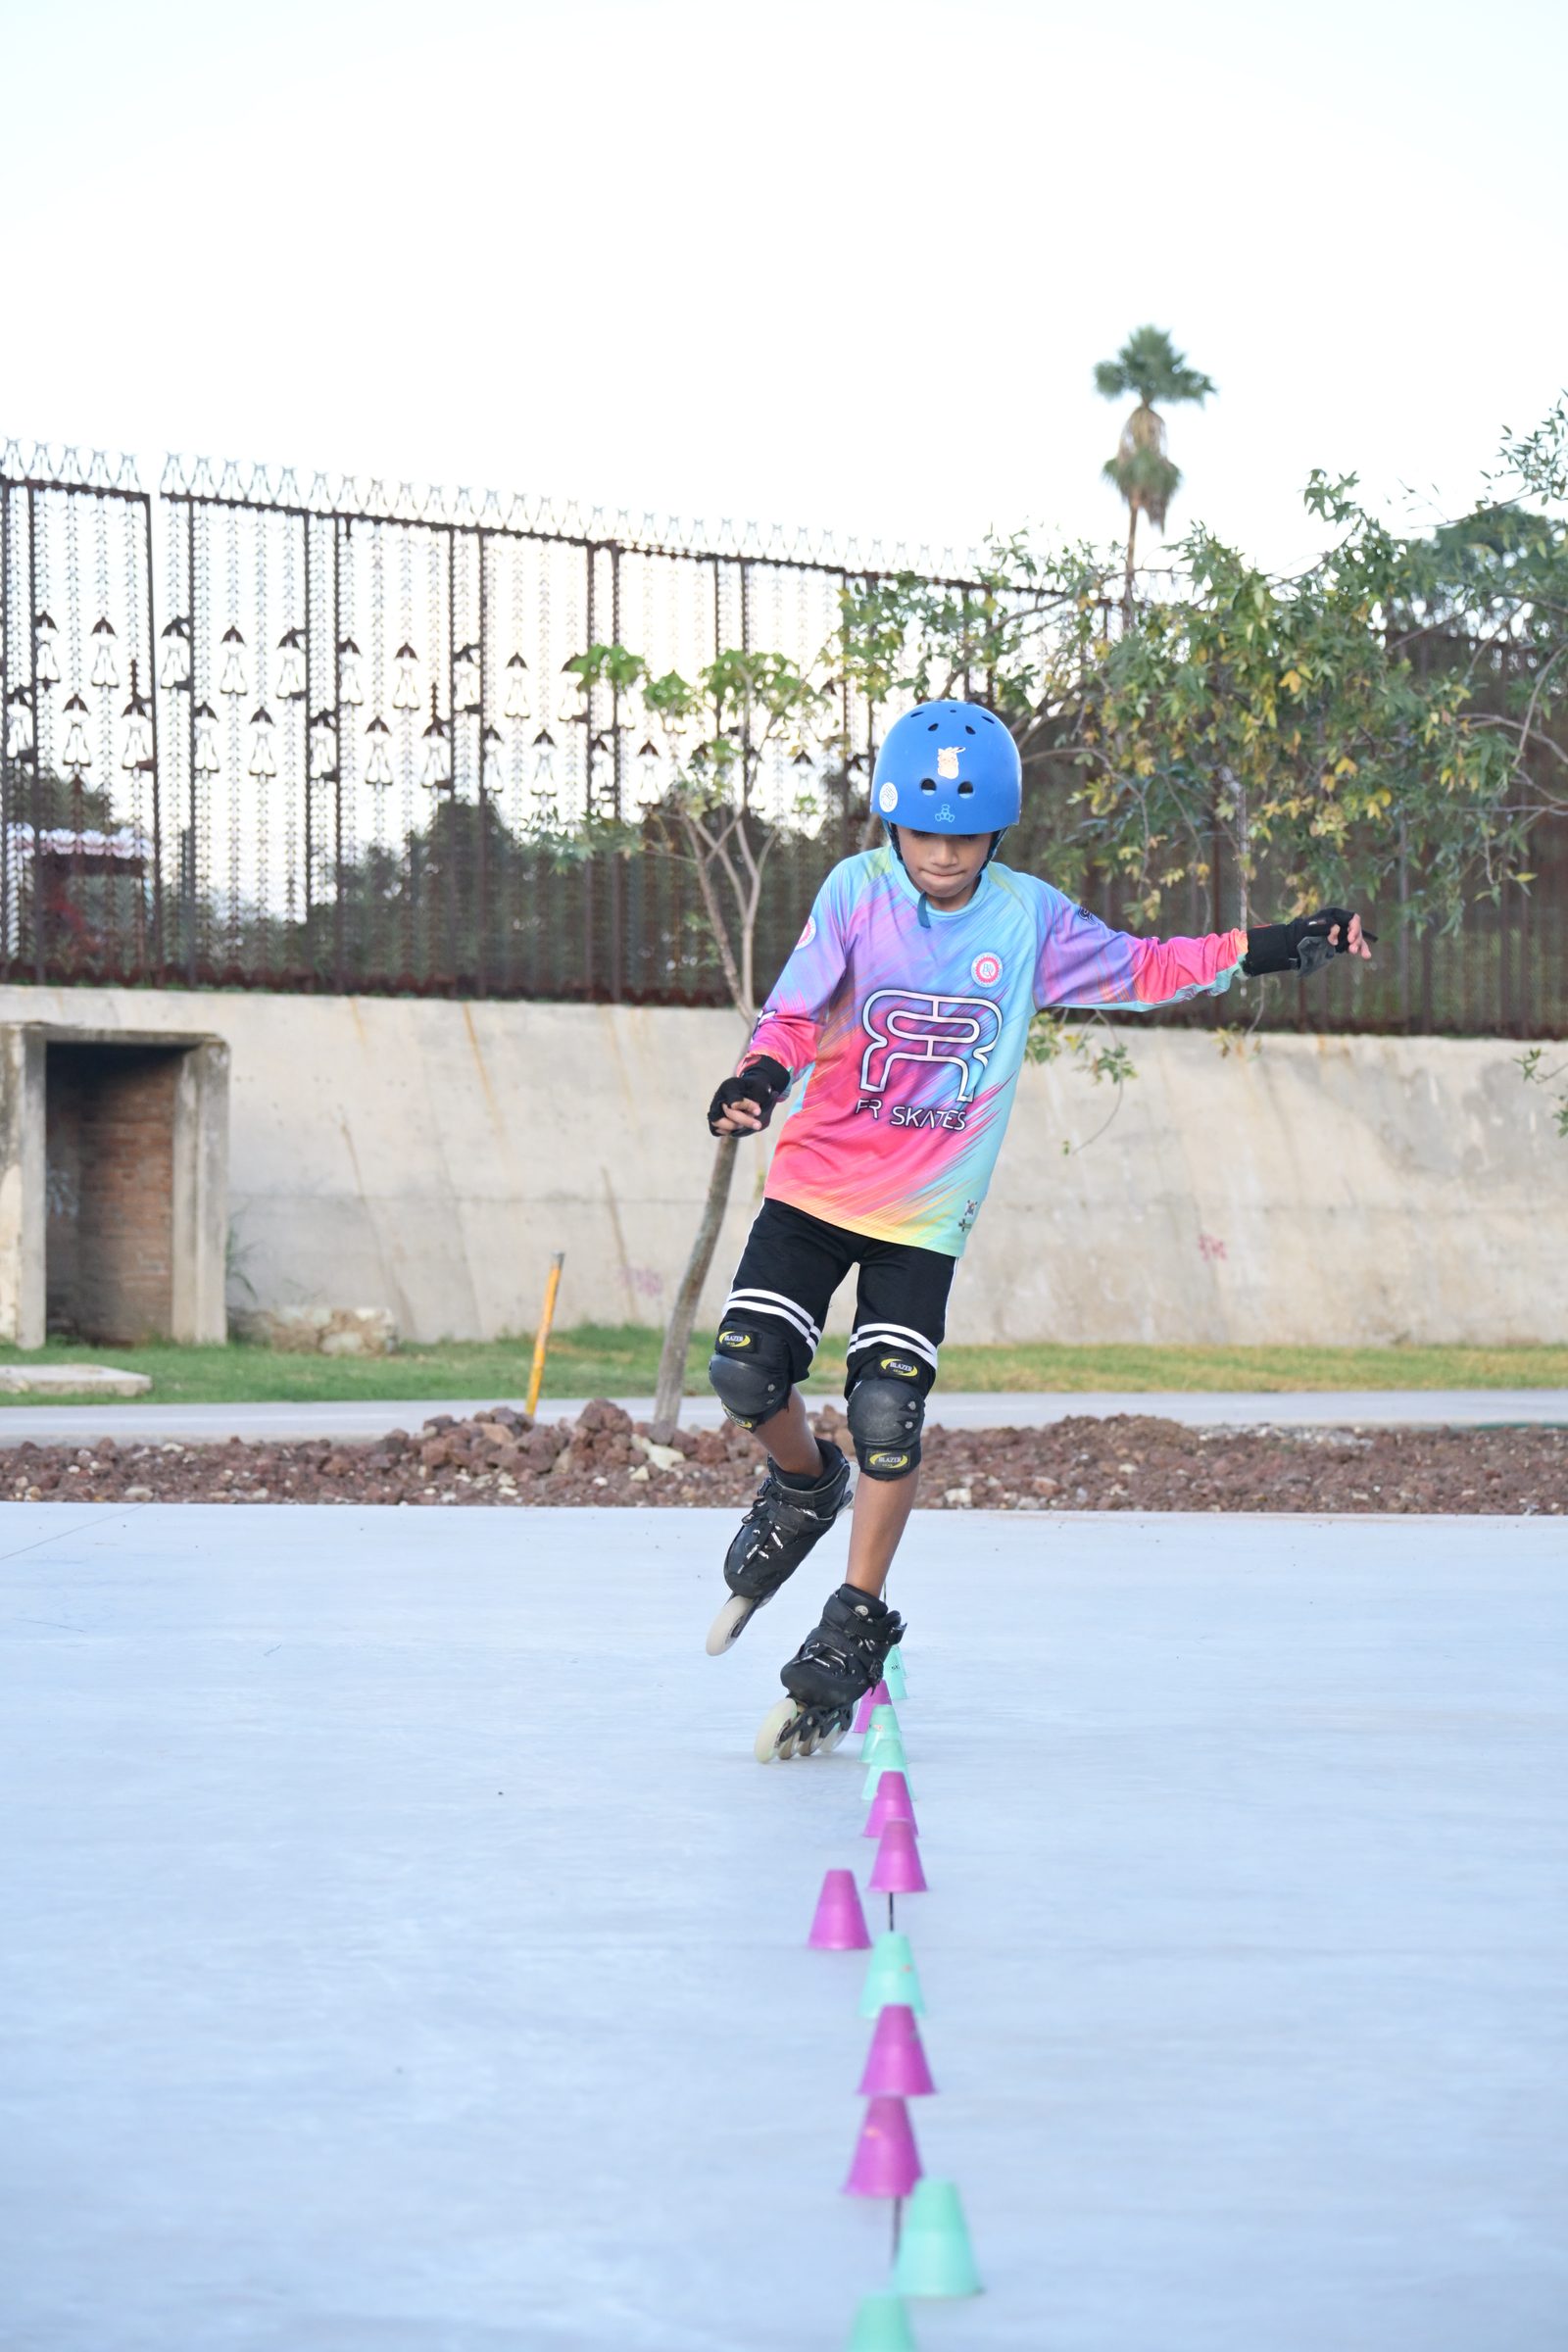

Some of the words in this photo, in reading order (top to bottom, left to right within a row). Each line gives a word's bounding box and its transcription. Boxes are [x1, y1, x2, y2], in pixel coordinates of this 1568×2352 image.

[855, 1098, 882, 1119] FR
[890, 1105, 966, 1131] SKATES
[889, 1361, 913, 1372] BLAZER
